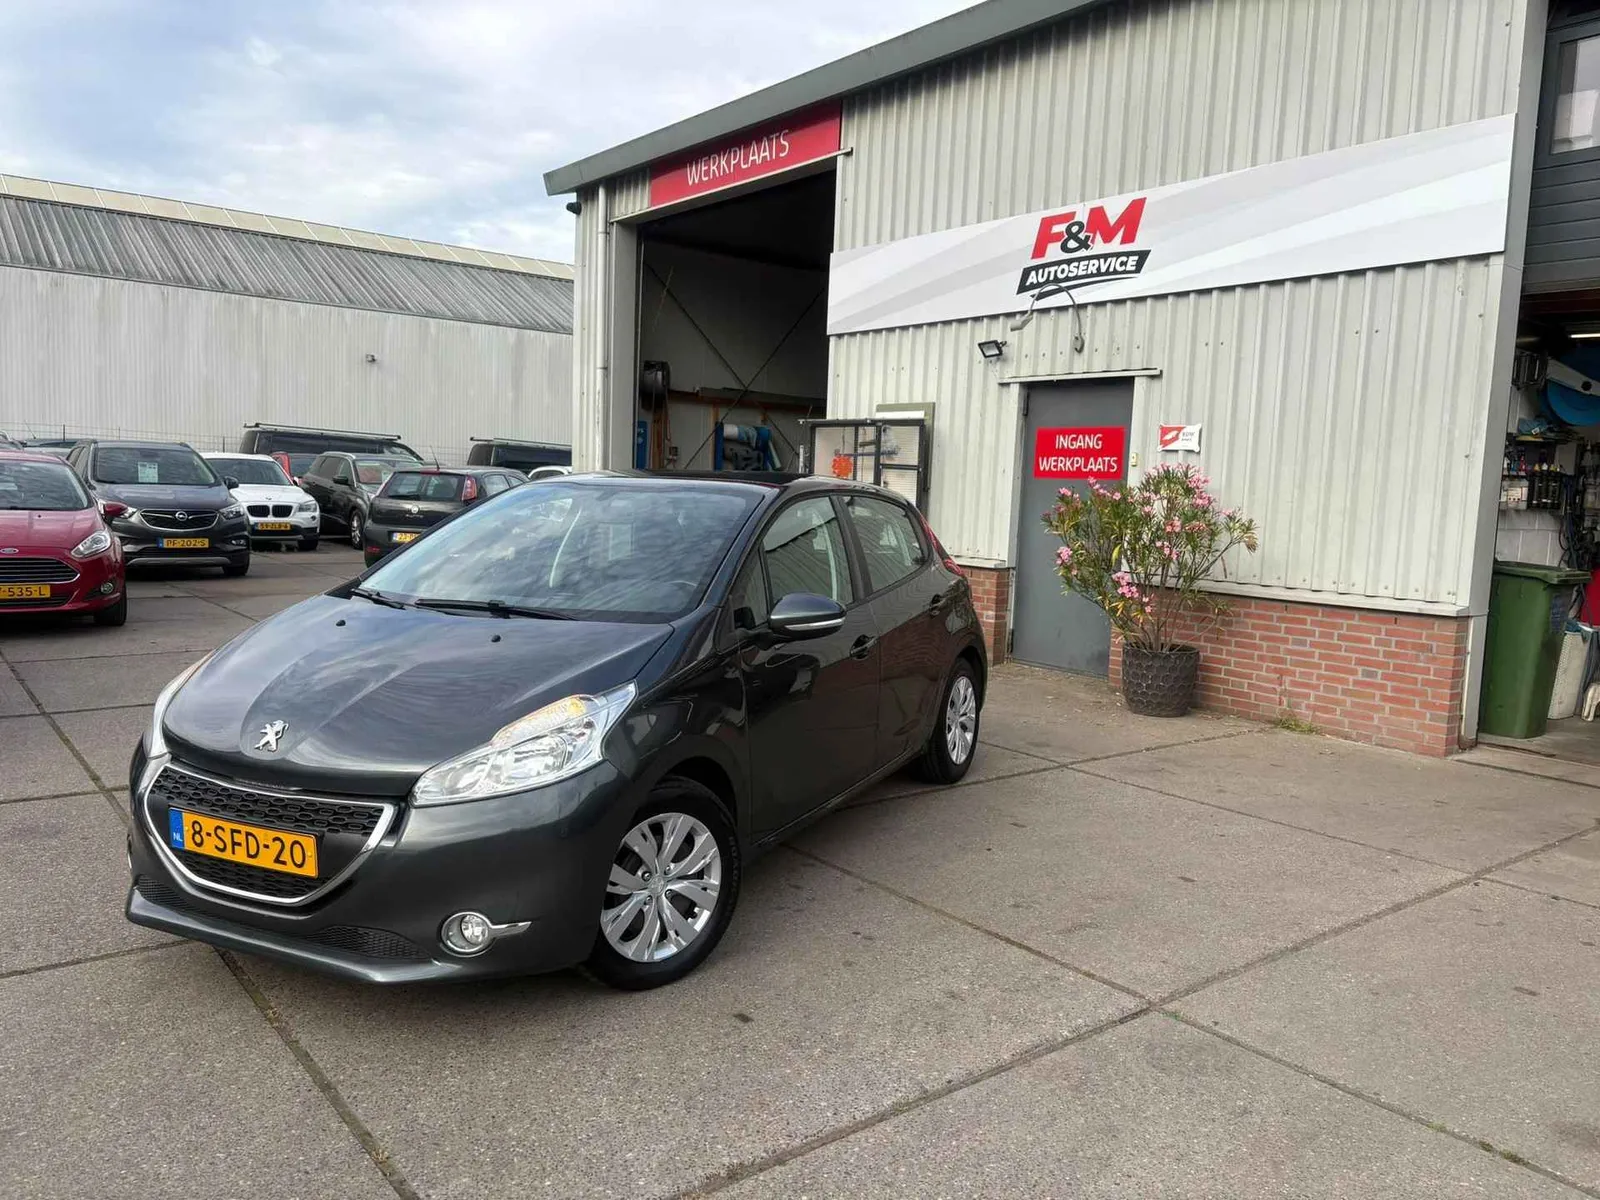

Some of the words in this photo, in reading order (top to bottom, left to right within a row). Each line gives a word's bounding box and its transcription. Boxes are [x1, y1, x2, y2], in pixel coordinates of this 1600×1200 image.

[686, 129, 790, 187] WERKPLAATS
[1030, 196, 1148, 260] F&M
[1025, 255, 1140, 286] AUTOSERVICE
[1055, 433, 1103, 450] INGANG
[1038, 456, 1119, 473] WERKPLAATS
[190, 819, 307, 869] 8-SFD-20
